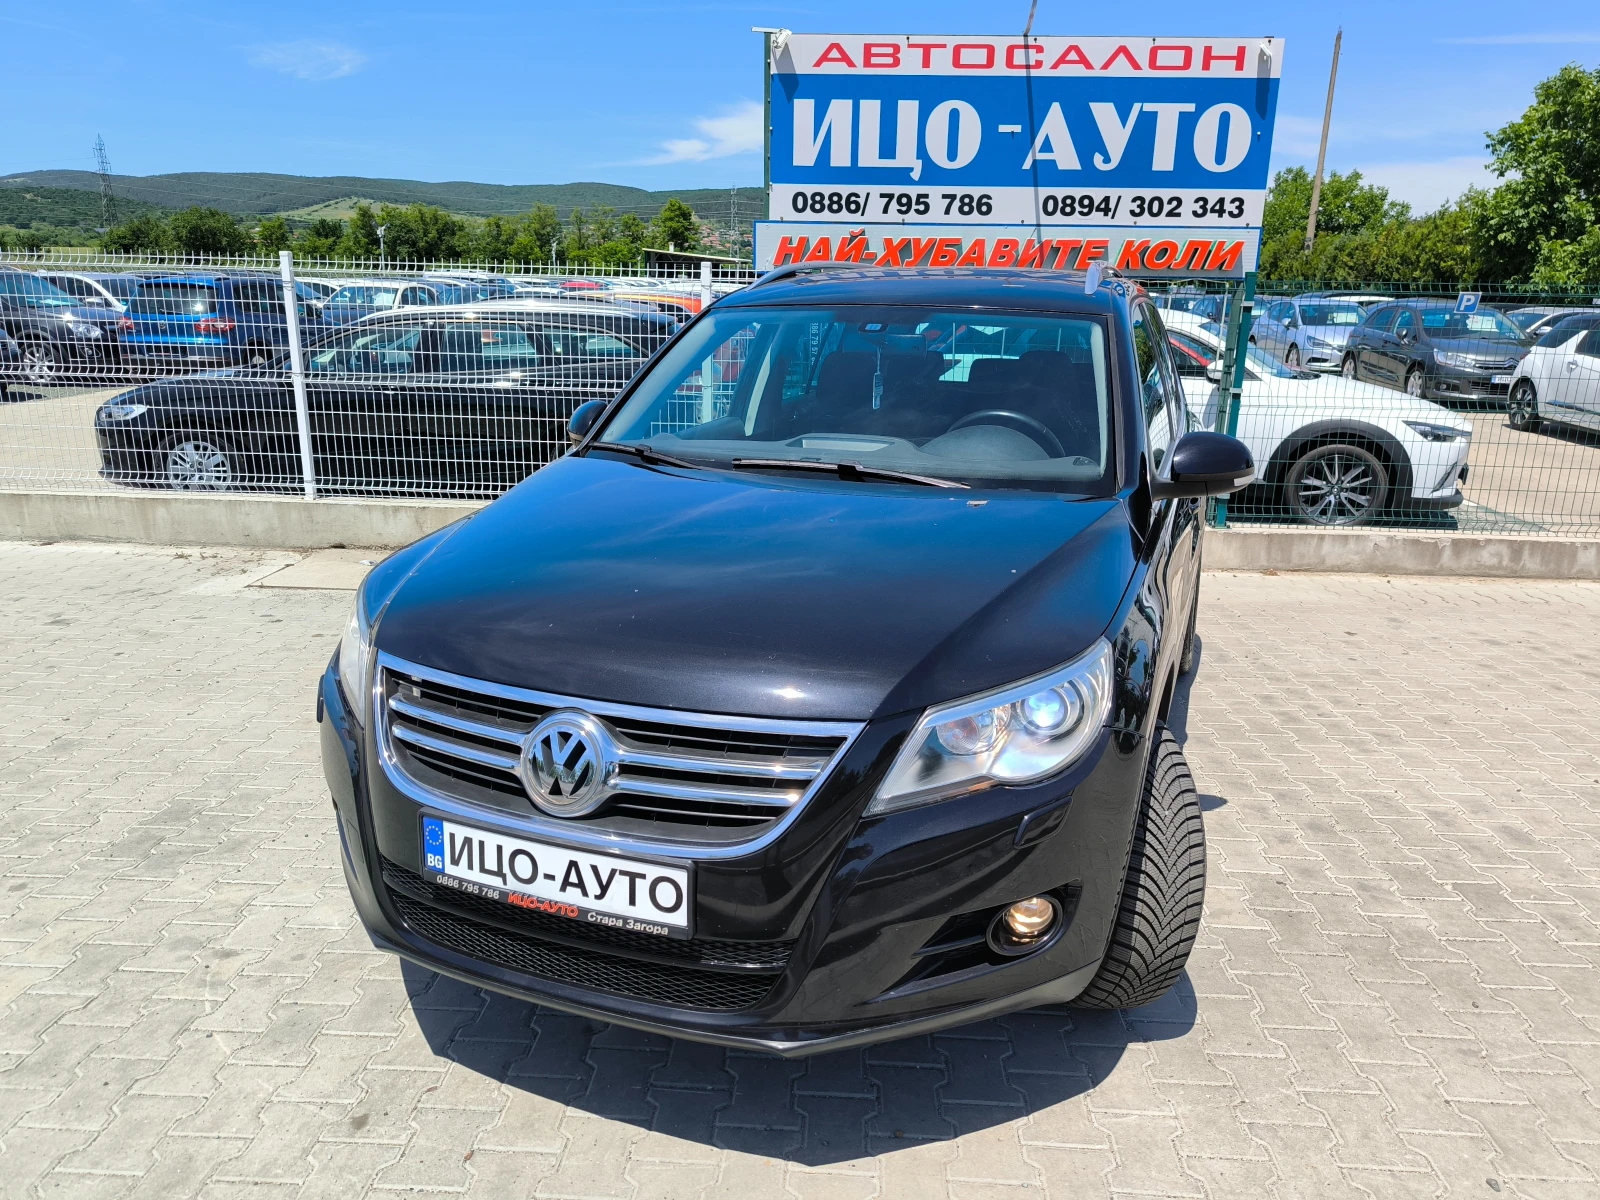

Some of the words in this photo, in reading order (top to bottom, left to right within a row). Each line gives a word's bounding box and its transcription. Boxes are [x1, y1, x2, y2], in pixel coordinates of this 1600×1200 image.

[813, 42, 1246, 71] АВТОСАЛОН
[791, 191, 870, 217] 0886/
[878, 193, 930, 216] 795
[941, 193, 993, 216] 786
[1042, 194, 1121, 220] 0894/
[1129, 196, 1182, 218] 302
[1191, 197, 1245, 219] 343
[773, 227, 1108, 270] НАЙ-ХУБАВИТЕ
[1116, 239, 1245, 271] КОЛИ
[427, 853, 443, 869] BG
[448, 831, 684, 914] ИЦО-АУТО
[436, 874, 459, 888] 0886
[461, 881, 479, 894] 795
[481, 887, 500, 899] 786
[507, 891, 579, 918] ИЦО-АУТО
[587, 911, 623, 927] Стара
[626, 919, 669, 936] Загора
